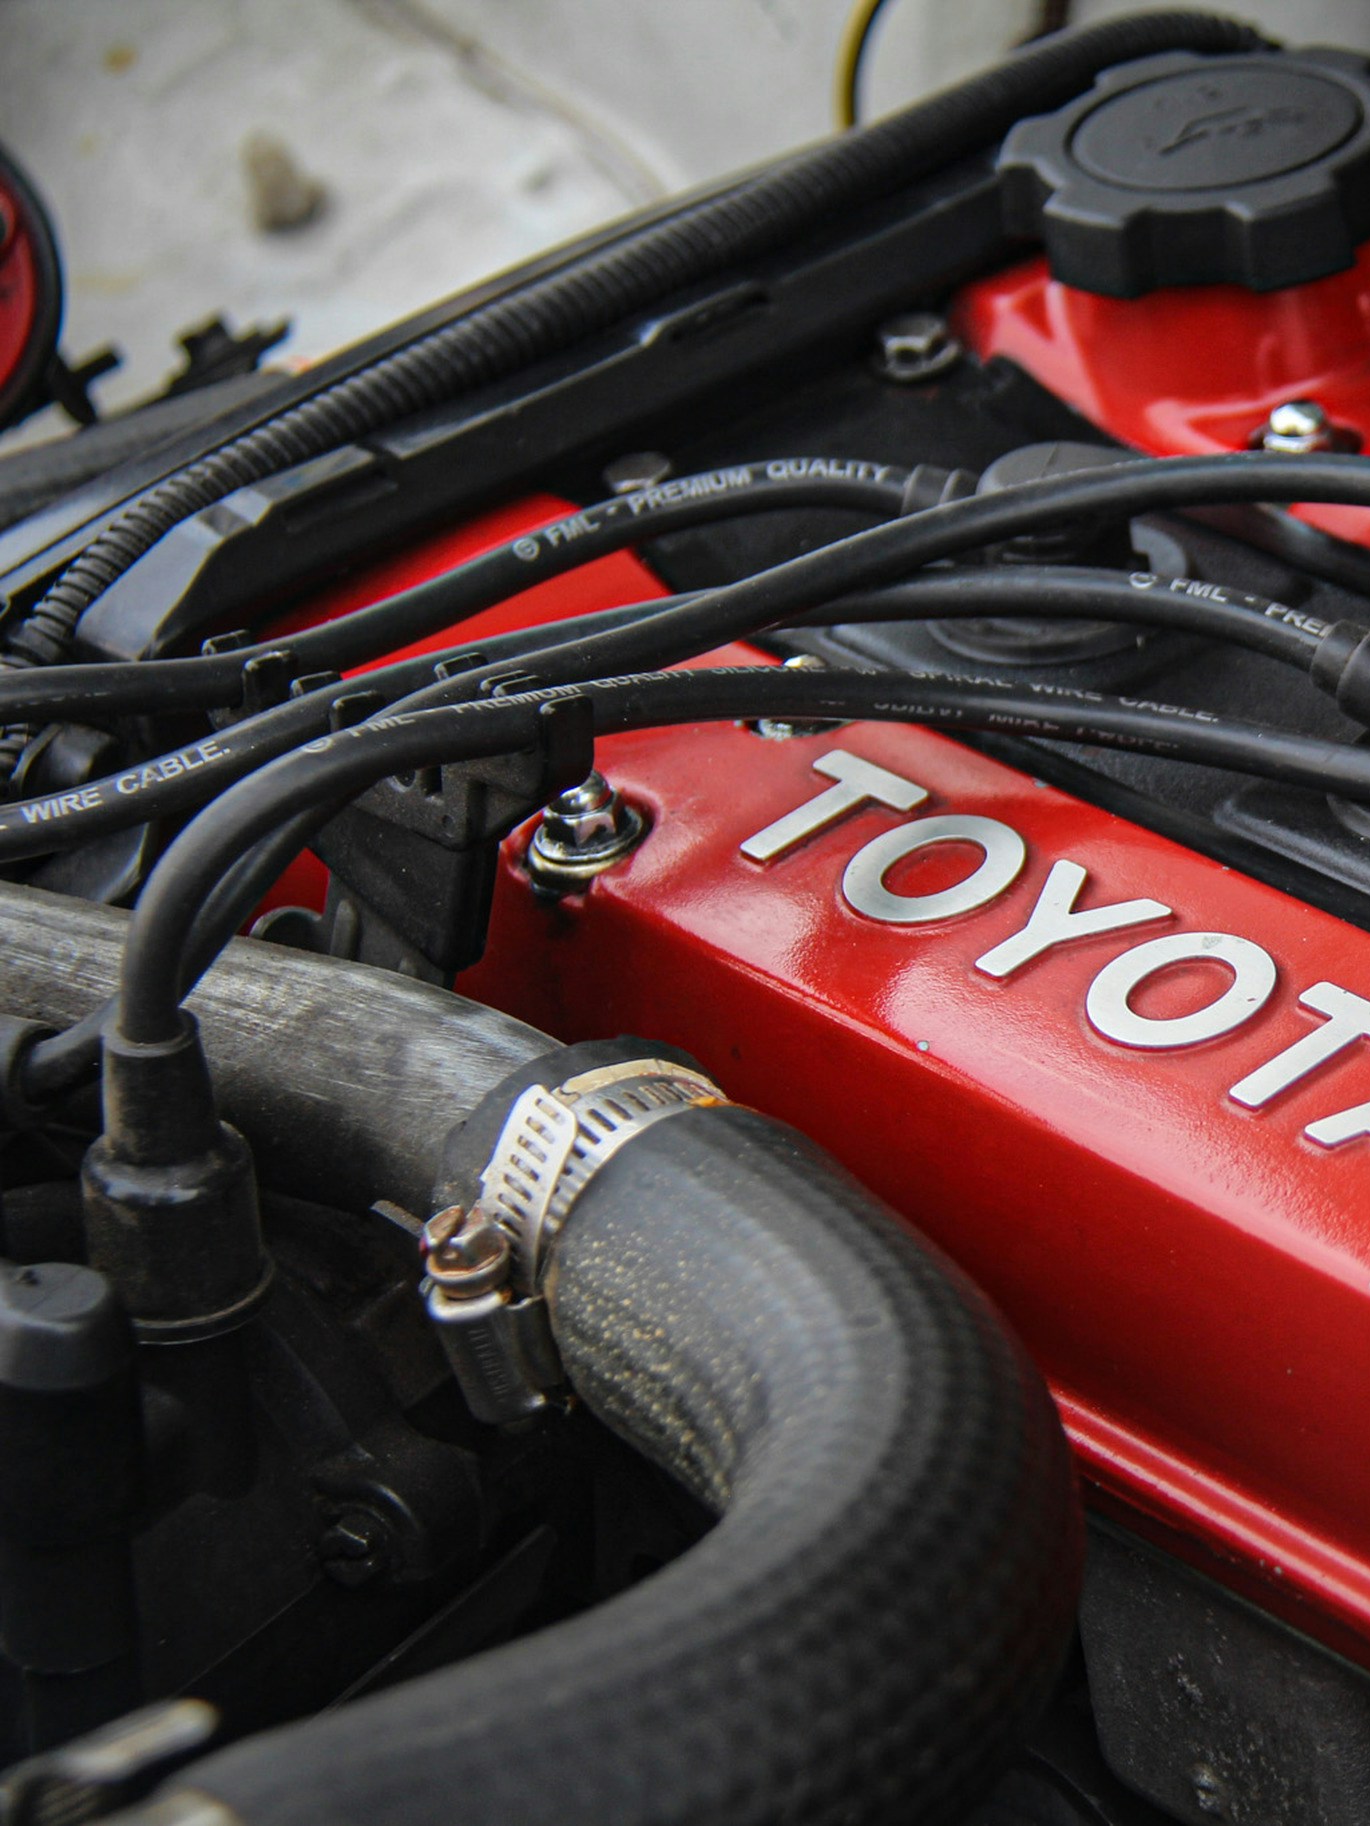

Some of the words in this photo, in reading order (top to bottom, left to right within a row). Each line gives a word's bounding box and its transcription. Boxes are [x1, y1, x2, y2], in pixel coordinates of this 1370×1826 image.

[543, 515, 600, 546] FML
[627, 467, 752, 515] PREMIUM
[766, 458, 890, 482] QUALITY
[1169, 577, 1228, 602] FML
[20, 786, 104, 825] WIRE
